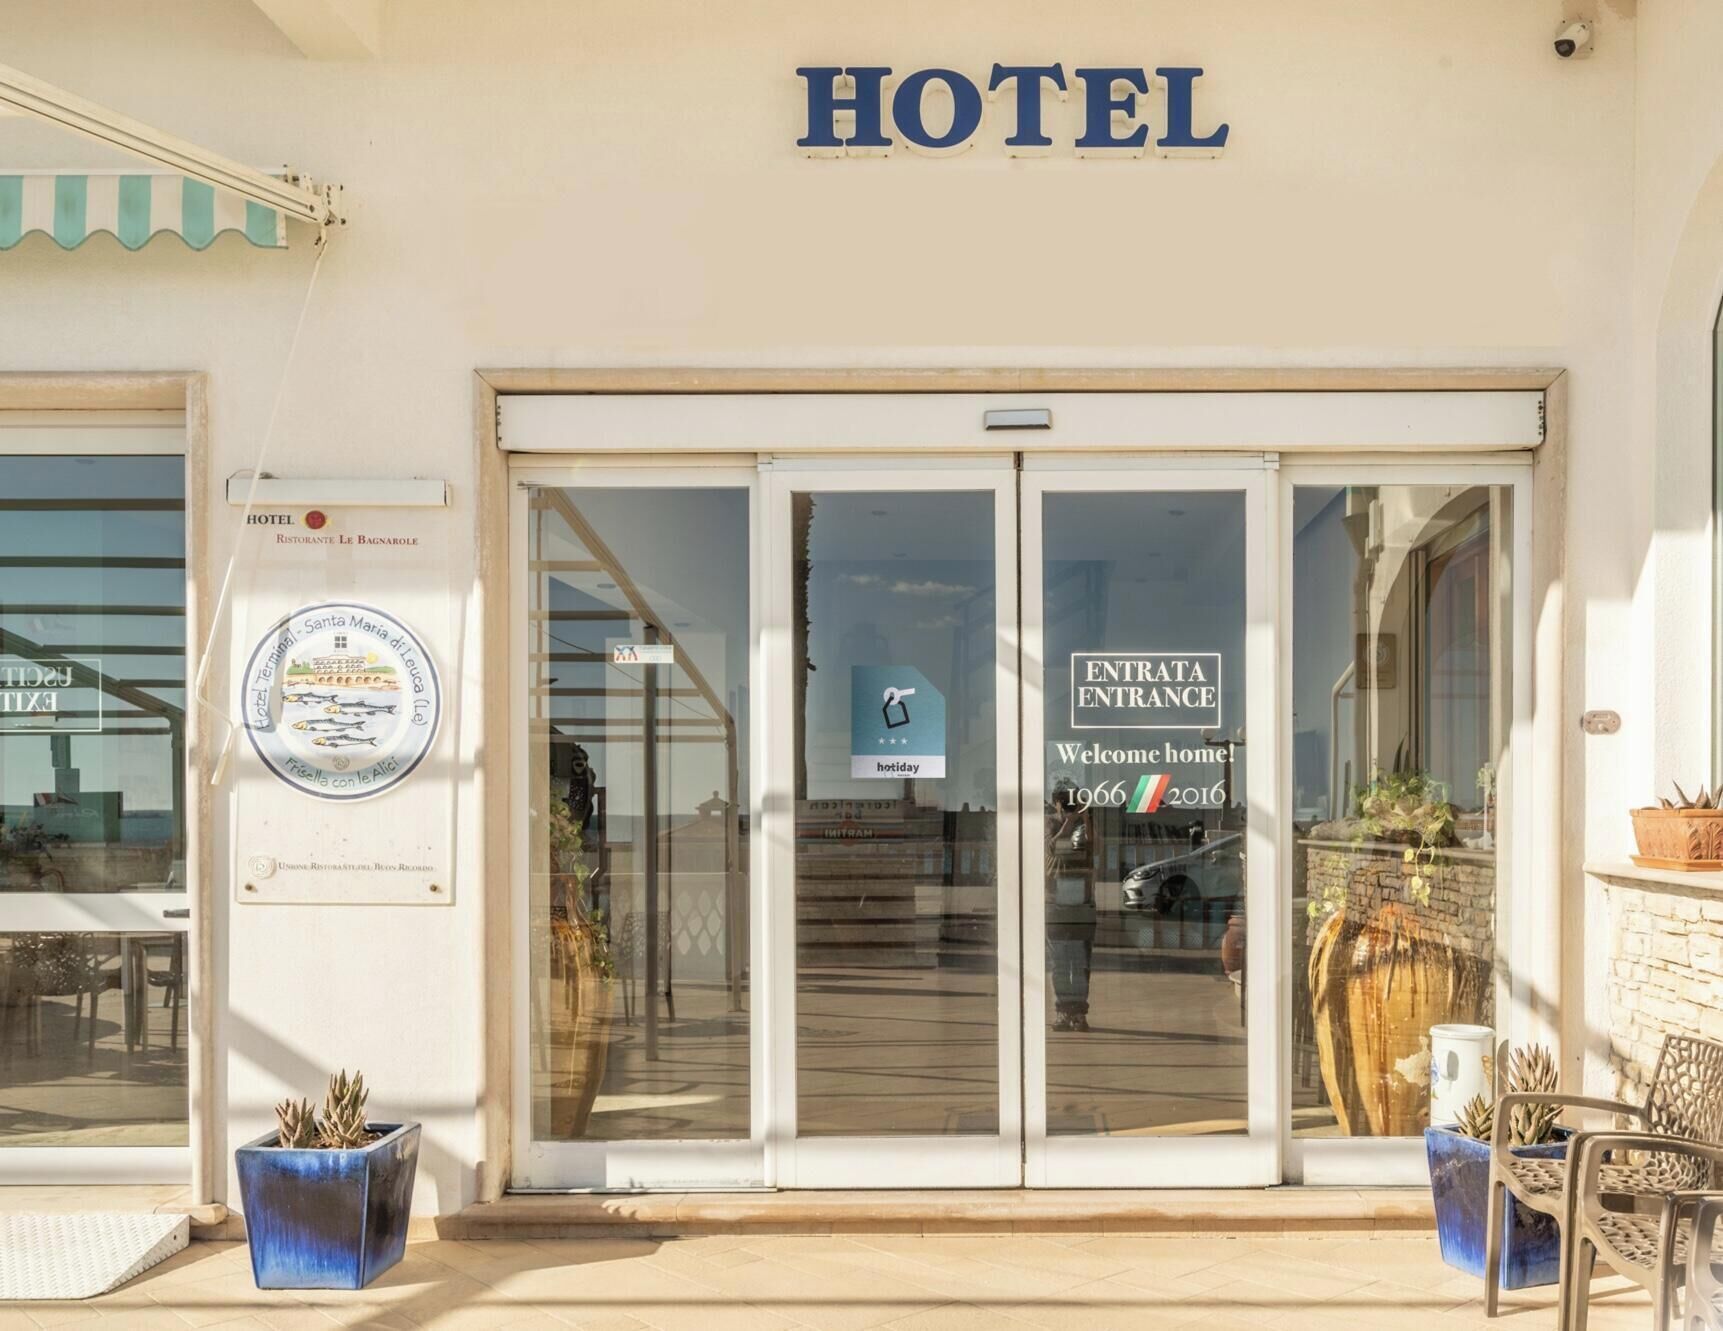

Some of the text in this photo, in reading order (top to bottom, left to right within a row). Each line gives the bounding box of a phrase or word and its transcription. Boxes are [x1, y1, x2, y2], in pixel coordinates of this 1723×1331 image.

[796, 62, 1229, 149] HOTEL
[246, 514, 295, 525] HOTEL
[276, 533, 335, 544] RISTORANTE
[304, 615, 346, 634] Santa
[349, 615, 389, 640] Maria
[390, 635, 406, 652] di
[255, 628, 298, 685] Terminal
[400, 647, 425, 694] Leuca
[1084, 660, 1207, 683] ENTRATA
[252, 686, 270, 730] Hotel
[1077, 686, 1216, 709] ENTRANCE
[411, 699, 430, 727] (Le)
[1055, 742, 1236, 765] Welcome home!
[285, 756, 400, 789] Frisella con le Alici
[876, 761, 920, 775] hotiday
[1066, 779, 1227, 814] 1966 2016
